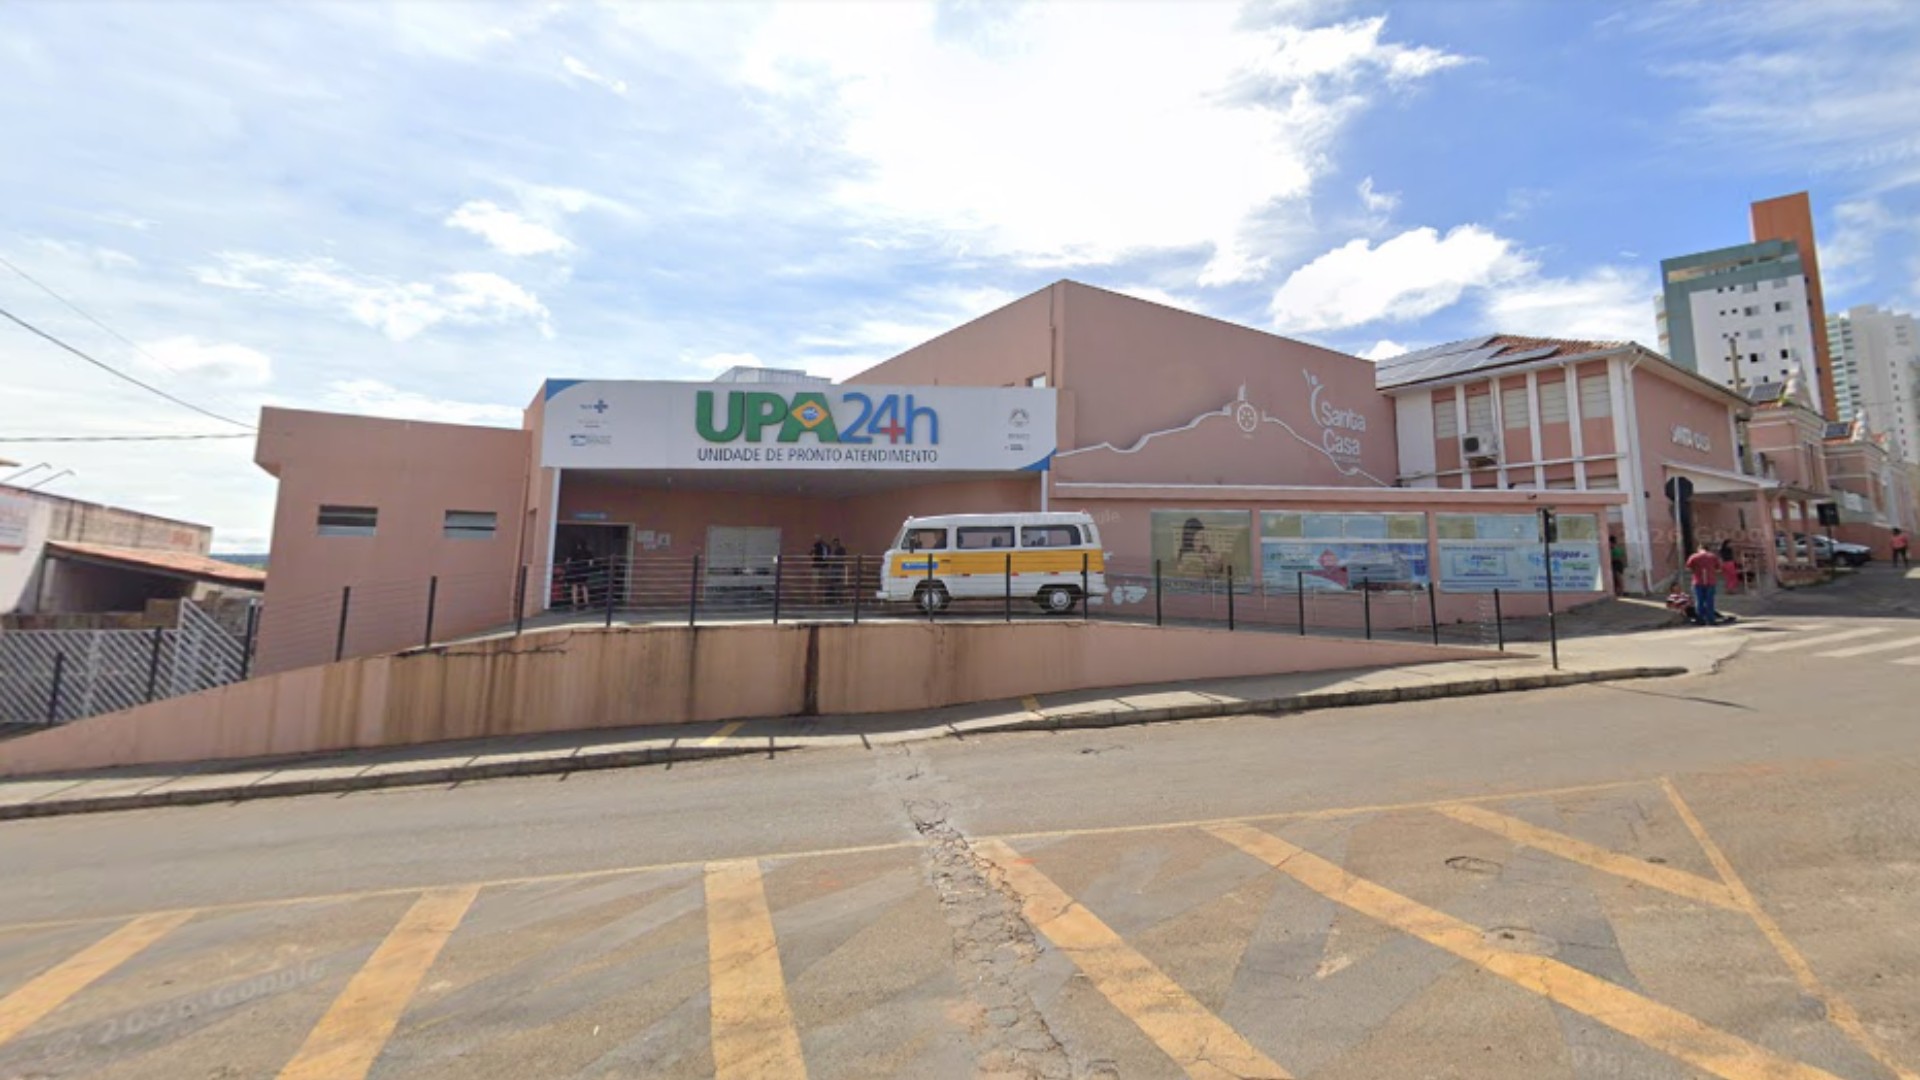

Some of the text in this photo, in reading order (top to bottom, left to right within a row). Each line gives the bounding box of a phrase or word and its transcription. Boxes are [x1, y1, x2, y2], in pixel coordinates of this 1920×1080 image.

[696, 390, 939, 445] UPA 24h
[1320, 399, 1366, 432] Santa
[697, 447, 939, 463] UNIDADE DE PRONTO ATENDIMENTO
[1323, 427, 1361, 455] Casa
